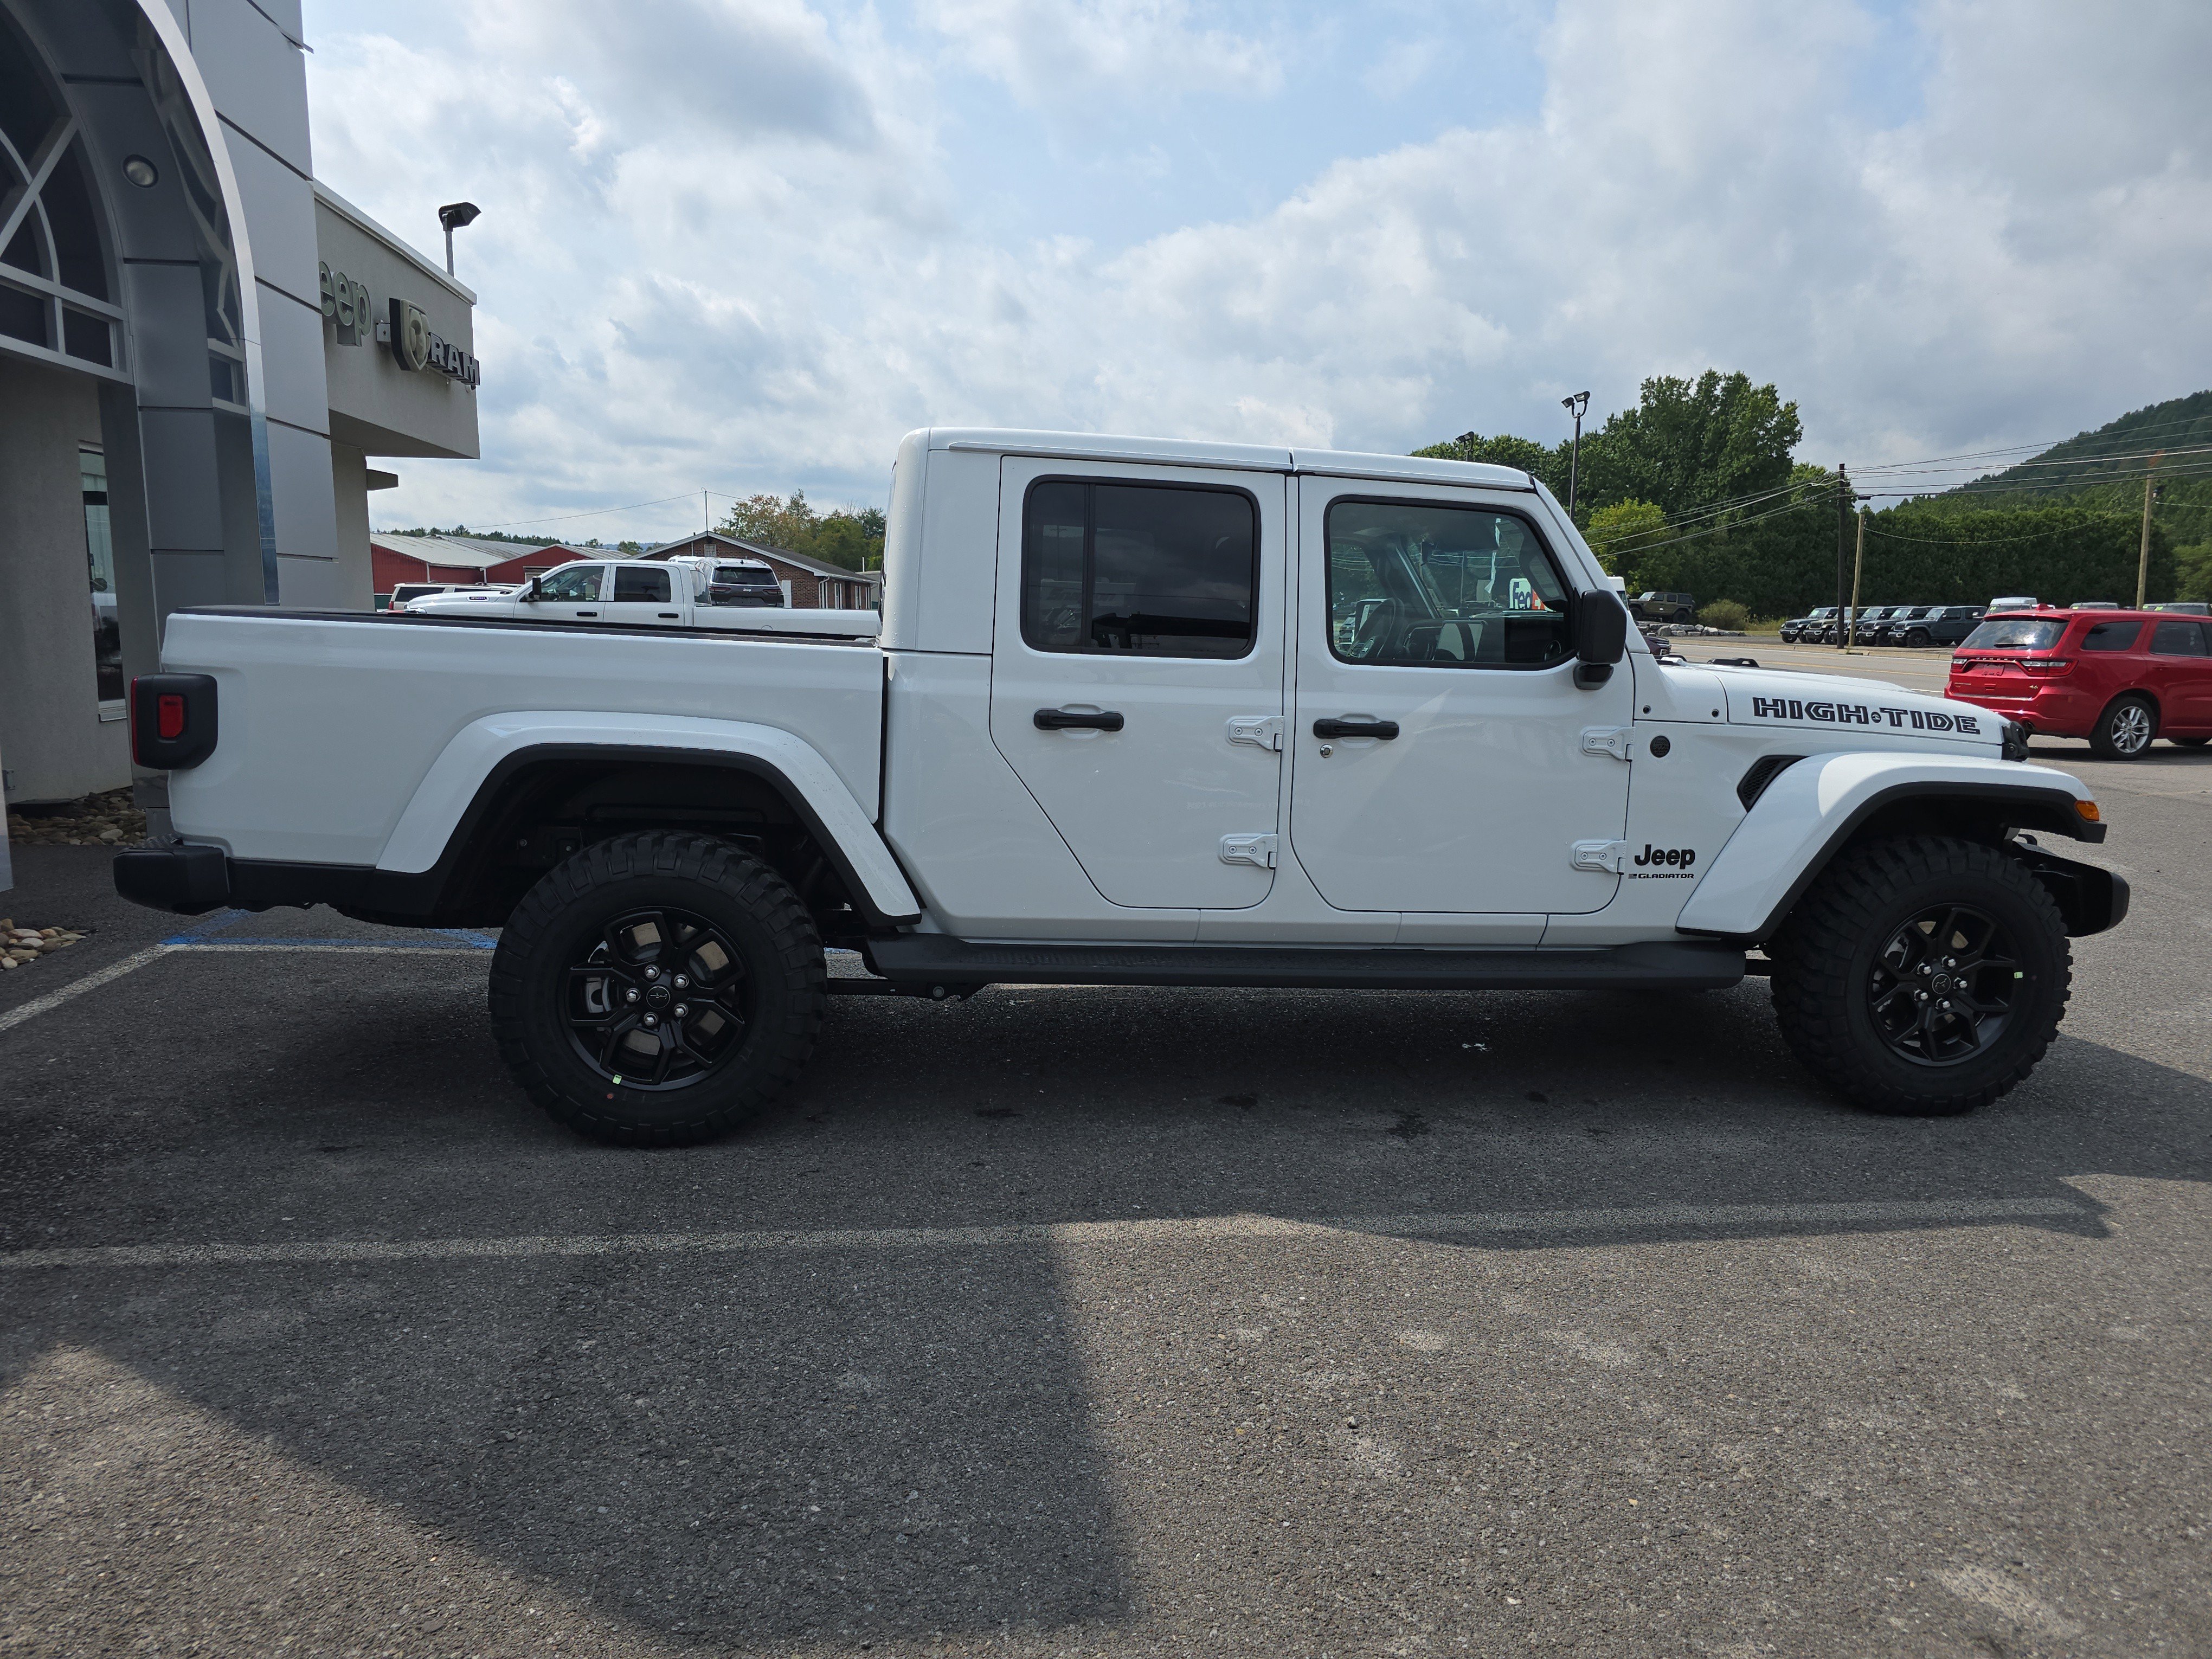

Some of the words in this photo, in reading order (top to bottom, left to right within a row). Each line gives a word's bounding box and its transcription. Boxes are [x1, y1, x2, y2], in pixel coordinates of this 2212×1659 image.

[319, 261, 371, 347] eep
[429, 332, 480, 385] RAM
[1752, 697, 1869, 725] HIGH
[1879, 706, 1981, 735] TIDE
[1634, 844, 1695, 870] Jeep
